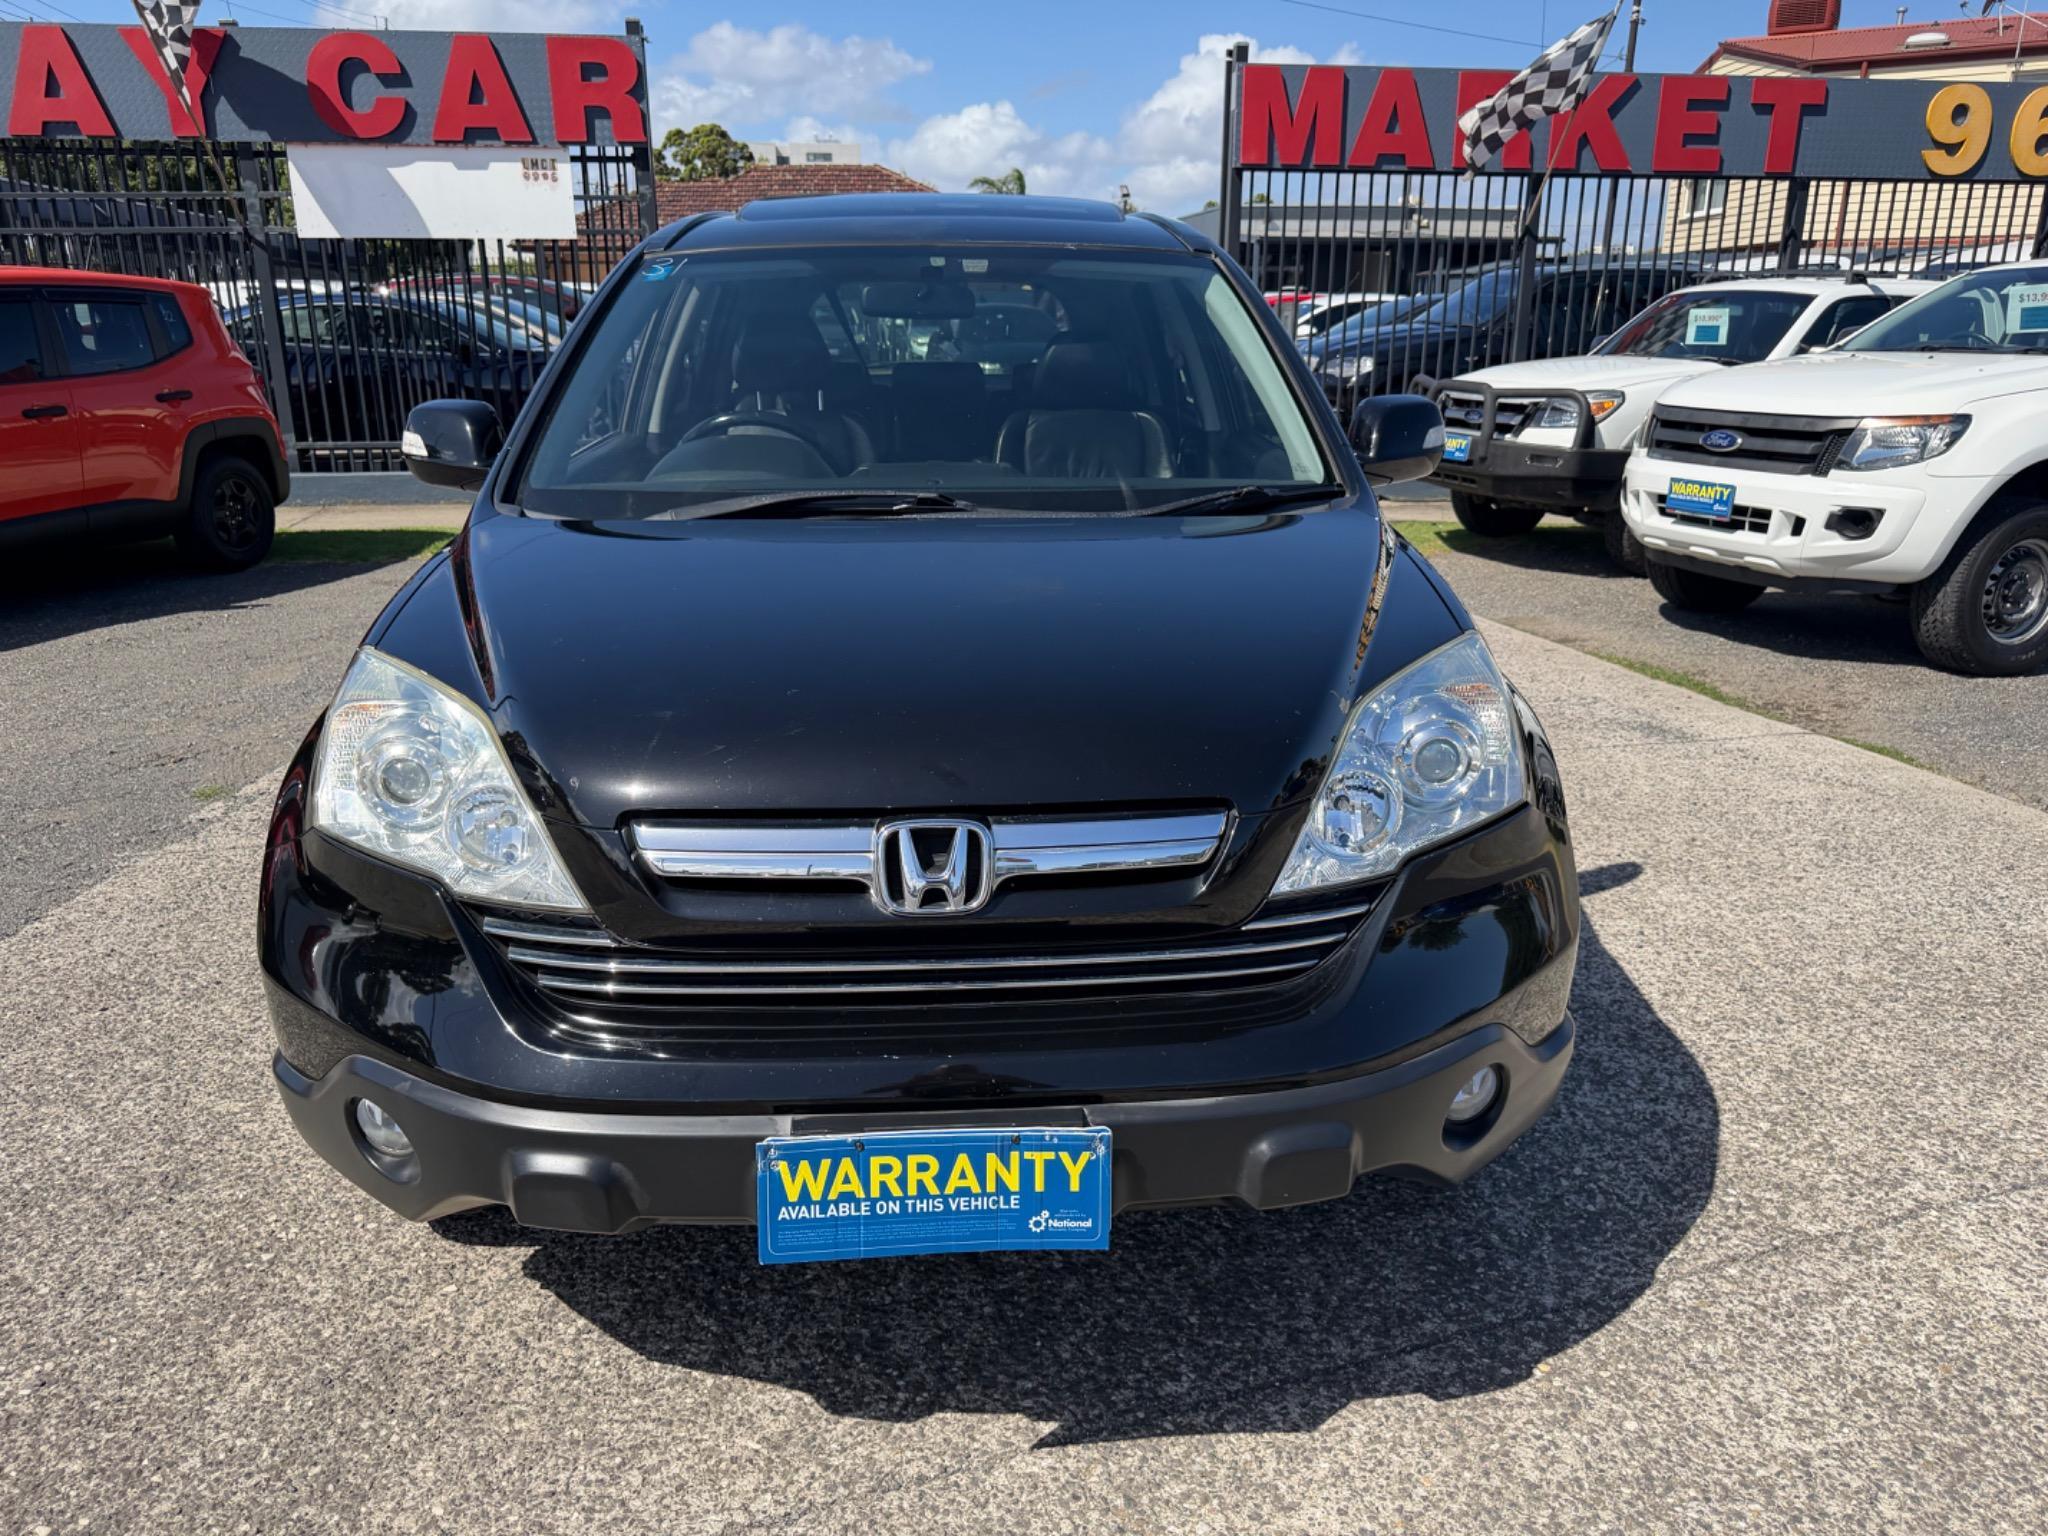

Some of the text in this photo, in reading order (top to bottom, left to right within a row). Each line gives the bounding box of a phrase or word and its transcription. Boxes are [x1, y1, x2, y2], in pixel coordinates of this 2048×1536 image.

[8, 24, 648, 142] AY CAR
[1240, 65, 1828, 174] MARKET
[1671, 481, 1731, 501] WARRANTY
[778, 1151, 1091, 1203] WARRANTY
[778, 1195, 1020, 1221] AVAILABLE ON THIS VEHICLE
[1048, 1218, 1092, 1228] National
